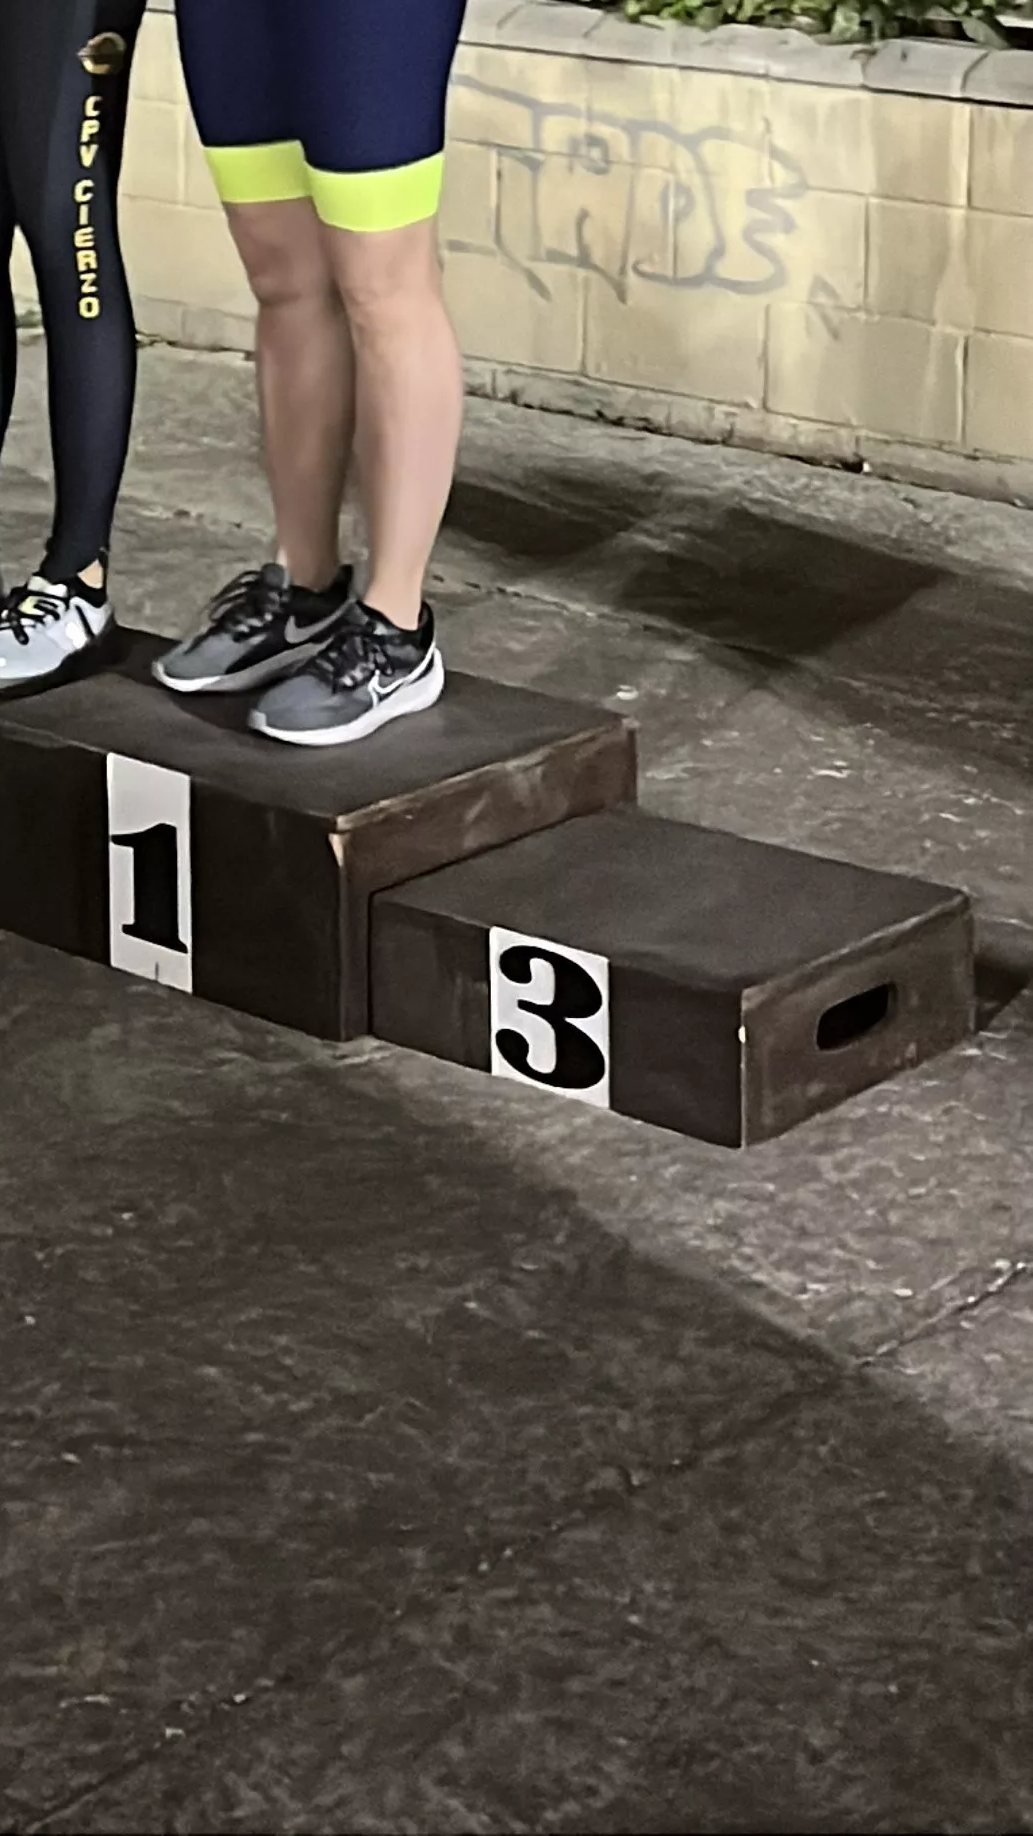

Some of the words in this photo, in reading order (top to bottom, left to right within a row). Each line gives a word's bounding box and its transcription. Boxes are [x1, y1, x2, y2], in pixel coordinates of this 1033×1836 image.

[79, 95, 103, 168] CPV
[73, 178, 100, 319] CIERZO
[110, 822, 189, 955] 1
[495, 945, 606, 1090] 3
